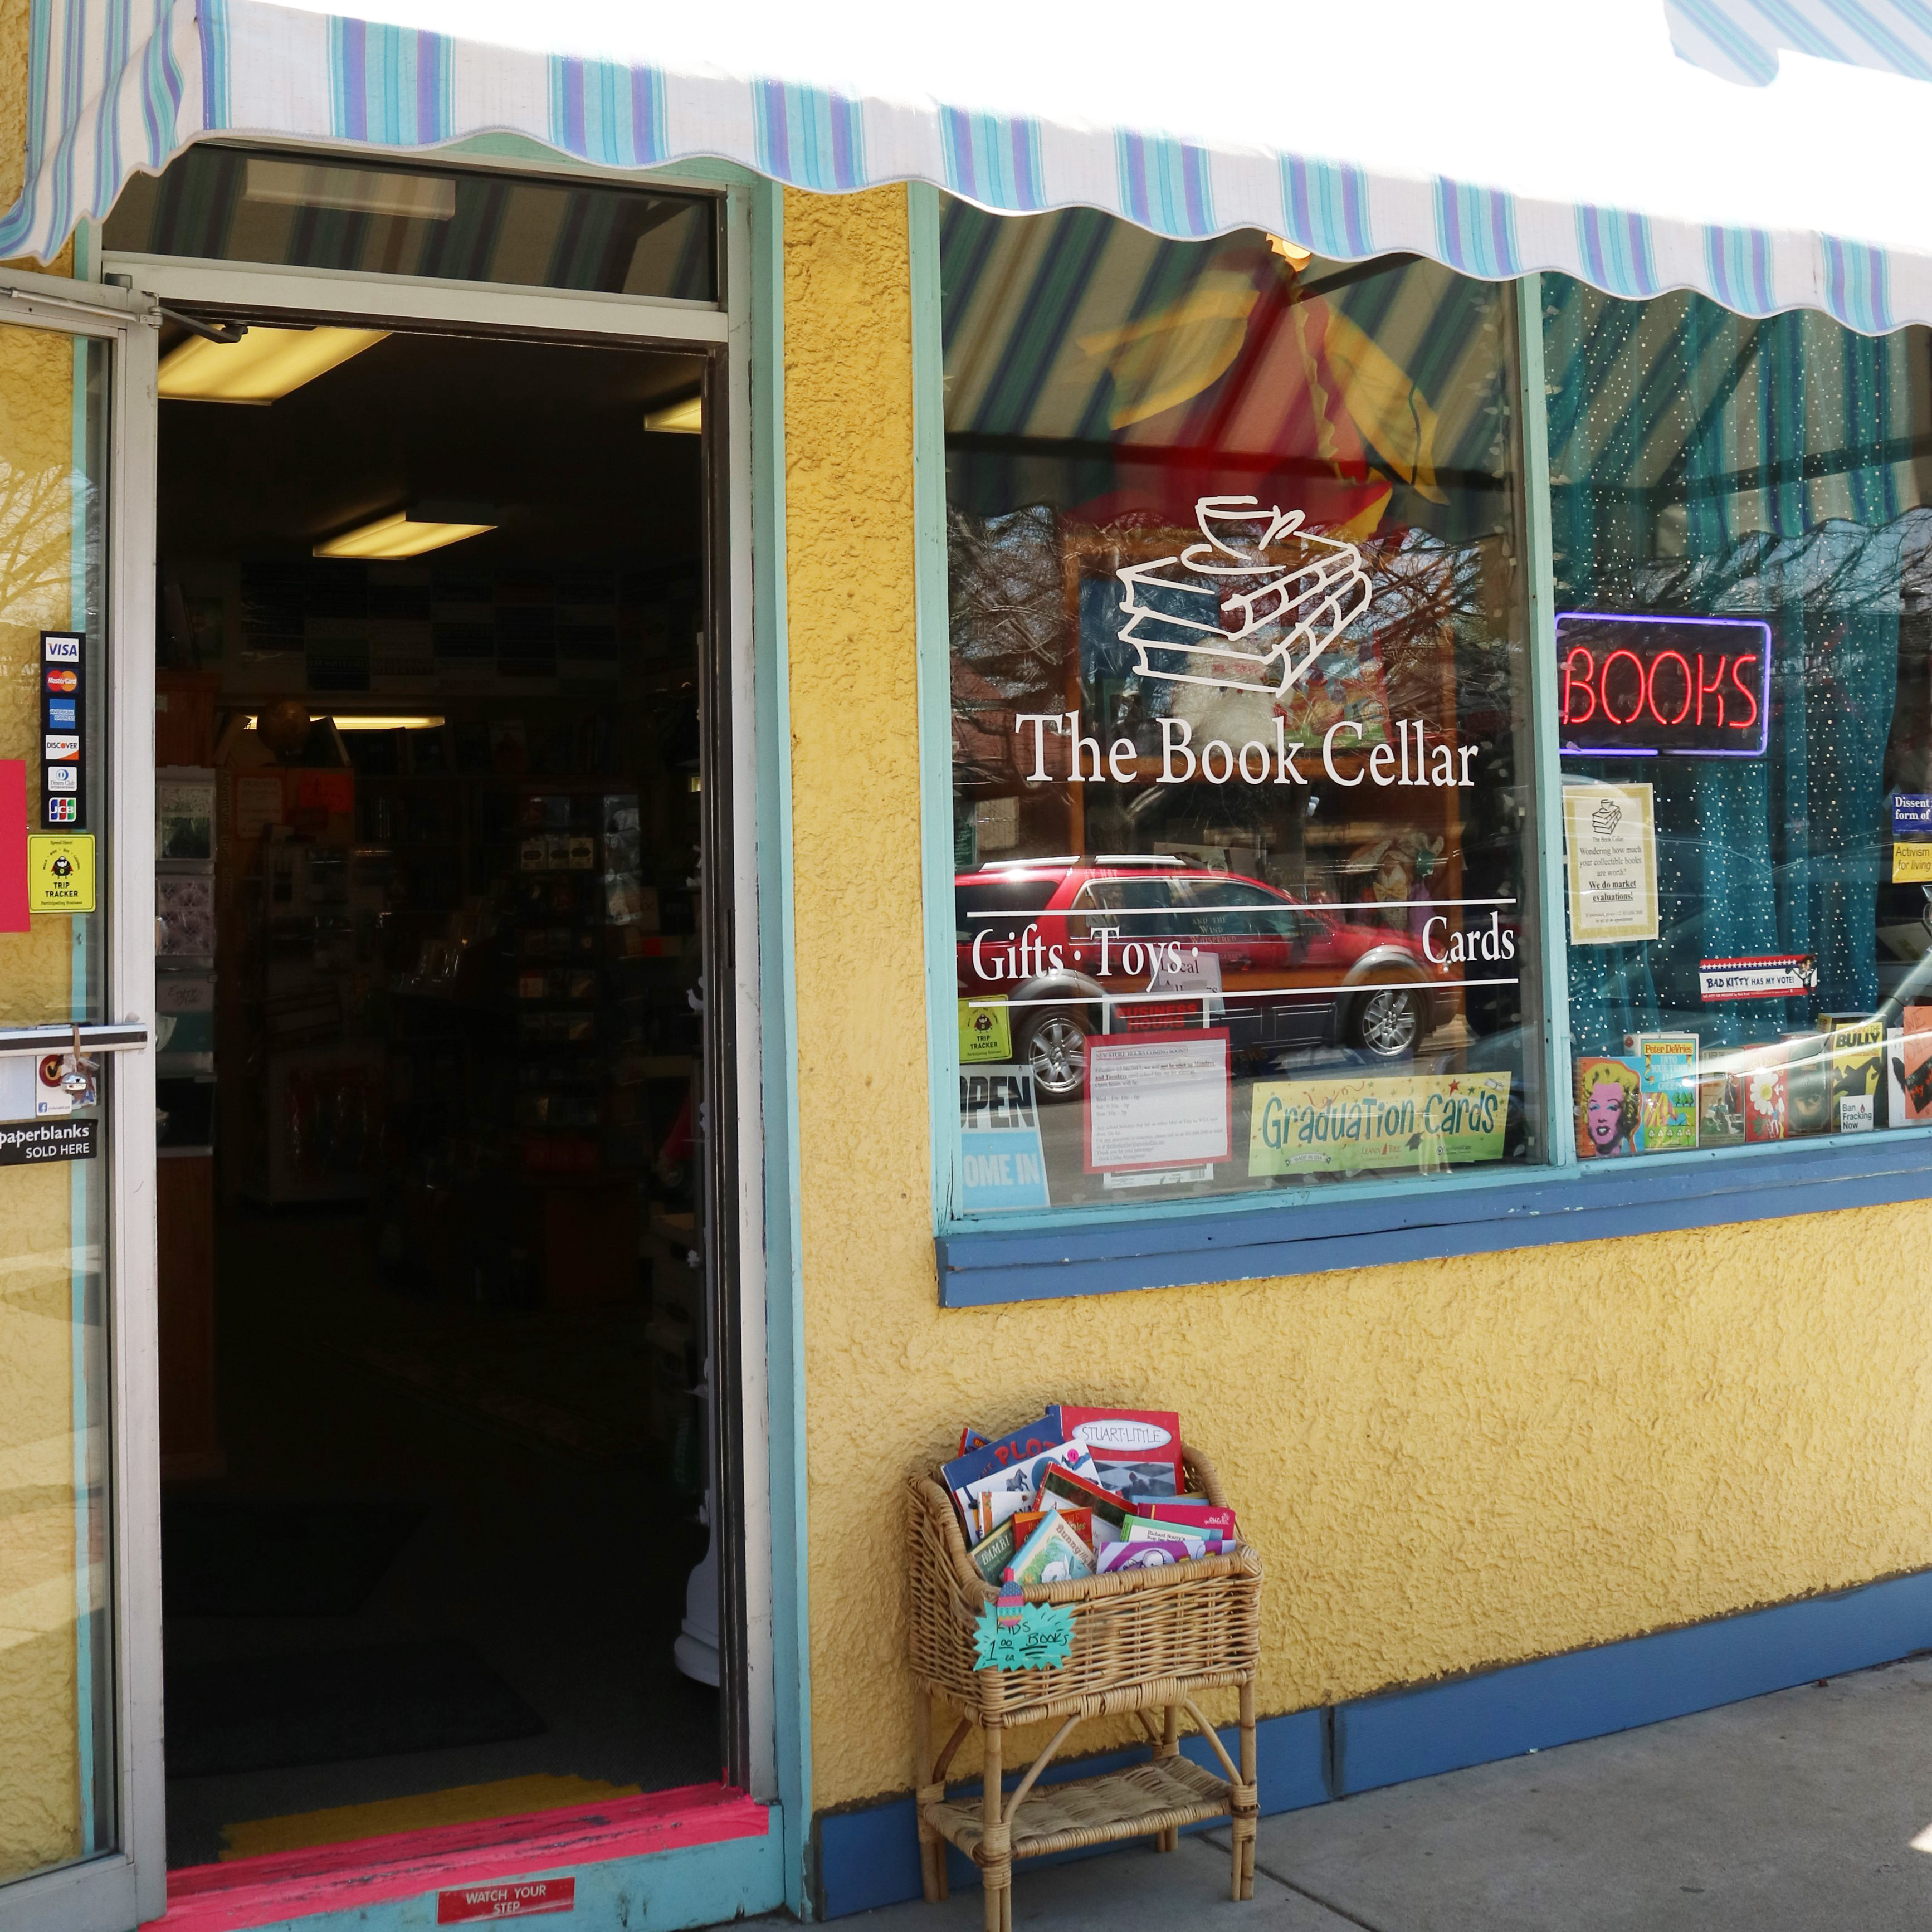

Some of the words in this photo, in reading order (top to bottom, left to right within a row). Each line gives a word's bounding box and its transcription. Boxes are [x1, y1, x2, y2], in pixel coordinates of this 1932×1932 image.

[48, 642, 77, 656] VISA
[47, 676, 77, 685] MasterCard
[1563, 647, 1757, 728] BOOKS
[1014, 710, 1138, 784] The
[1155, 716, 1308, 786] Book
[1321, 719, 1479, 788] Cellar
[1895, 796, 1930, 808] Dissent
[1895, 809, 1919, 820] form
[1920, 809, 1931, 820] of
[1579, 847, 1611, 856] Wondering
[1626, 845, 1642, 853] much
[1896, 846, 1930, 857] Activism
[1593, 857, 1623, 866] collectible
[1624, 856, 1642, 865] books
[1898, 860, 1910, 870] for
[1911, 860, 1931, 872] living
[1589, 881, 1600, 889] We
[1602, 880, 1611, 889] do
[1612, 879, 1636, 888] market
[1593, 891, 1633, 902] evaluations!
[972, 923, 1064, 980] Gifts
[1090, 925, 1182, 993] Toys
[1422, 911, 1515, 963] Cards
[1160, 958, 1199, 974] Local
[1706, 978, 1724, 989] BAD
[1726, 976, 1749, 988] KITTY
[1115, 1003, 1197, 1019] BUSINESS
[1126, 1015, 1185, 1031] HOURS
[1836, 1032, 1880, 1047] BULLY
[1645, 1045, 1665, 1053] Peter
[1666, 1044, 1692, 1053] DeVries
[1651, 1065, 1670, 1073] YOUR
[1671, 1065, 1688, 1073] TENT
[1842, 1111, 1872, 1120] Fracking
[0, 1124, 89, 1149] paperblanks
[26, 1147, 57, 1159] SOLD
[60, 1143, 90, 1155] HERE
[964, 1154, 1014, 1188] OME
[1015, 1152, 1041, 1185] IN
[1056, 1524, 1081, 1554] Bunny
[981, 1535, 1011, 1566] BAMBI
[1026, 1632, 1069, 1646] BOOKS
[466, 1889, 508, 1905] WATCH
[514, 1885, 547, 1900] YOUR
[494, 1901, 520, 1915] STEP
